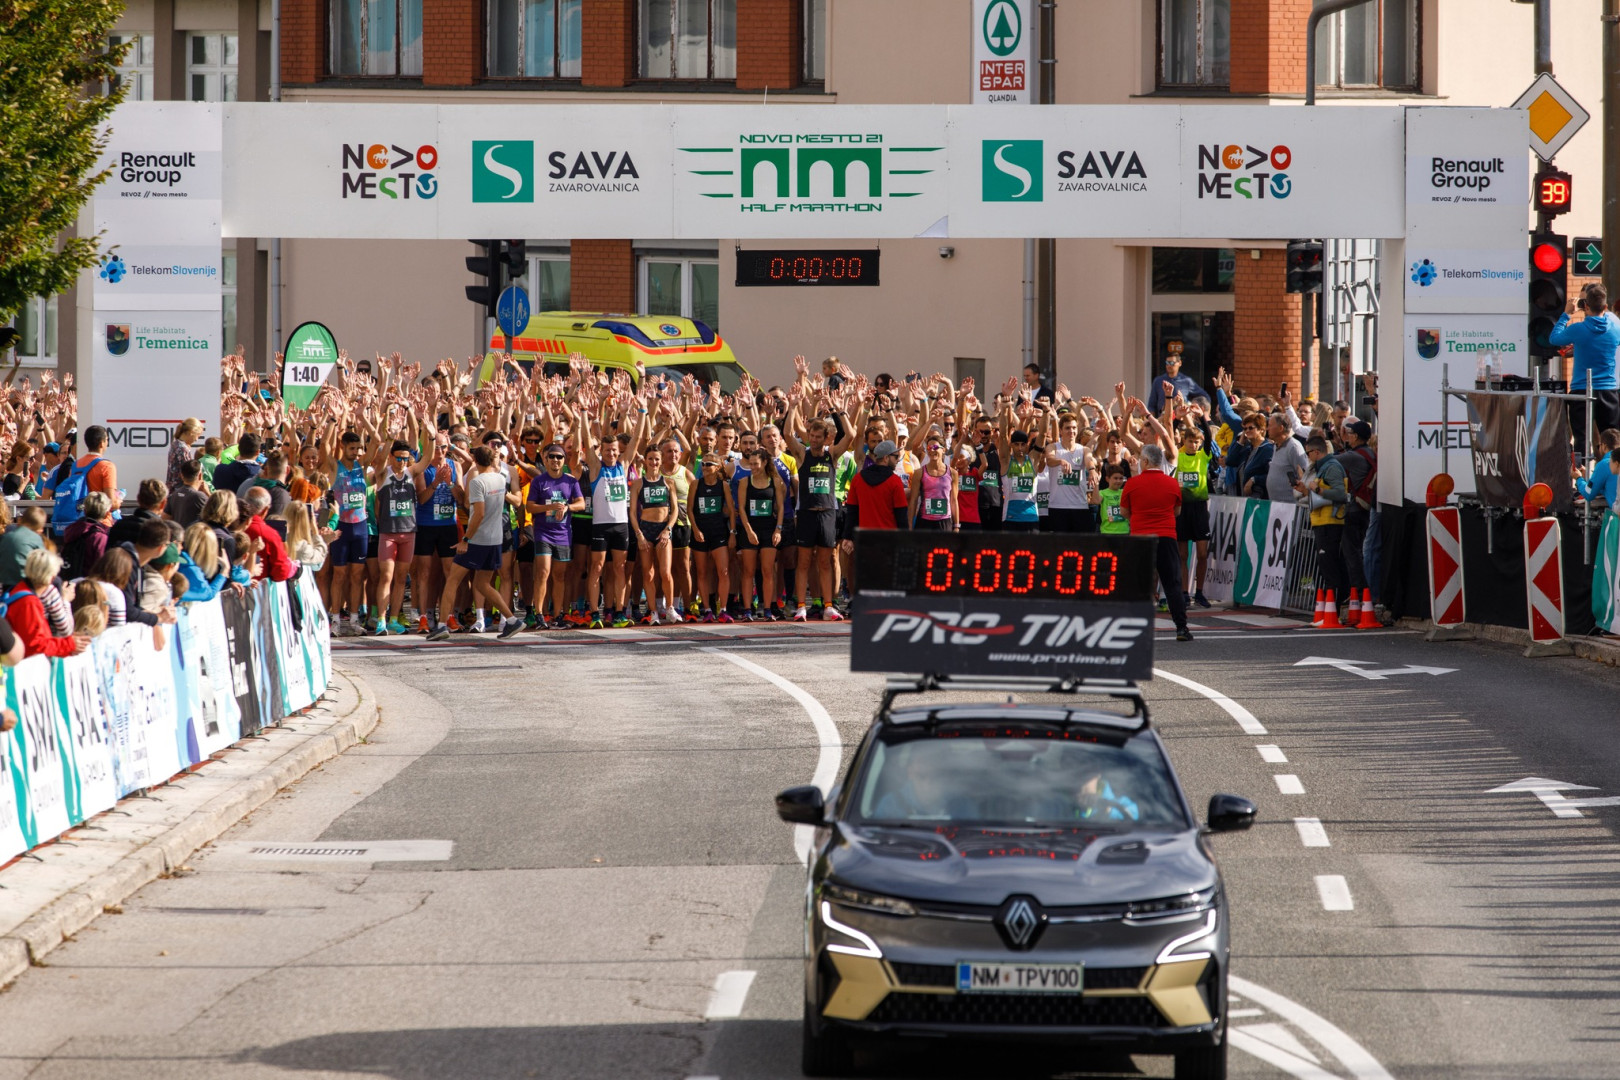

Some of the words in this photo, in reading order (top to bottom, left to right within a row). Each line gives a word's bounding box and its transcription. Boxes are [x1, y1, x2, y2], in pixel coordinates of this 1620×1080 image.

[981, 62, 1024, 75] INTER
[982, 76, 1023, 88] SPAR
[988, 94, 1017, 103] QLANDIA
[740, 134, 793, 143] NOVO
[796, 134, 862, 143] MESTO
[866, 134, 883, 143] 21
[121, 151, 196, 168] Renault
[548, 150, 640, 179] SAVA
[1057, 150, 1147, 179] SAVA
[1431, 157, 1504, 173] Renault
[120, 168, 182, 187] Group
[1431, 173, 1491, 192] Group
[342, 172, 438, 199] MESTO
[549, 182, 640, 193] ZAVAROVALNICA
[1058, 182, 1148, 192] ZAVAROVALNICA
[1198, 172, 1291, 199] MESTO
[1541, 182, 1565, 204] 39
[741, 203, 786, 212] HALF
[790, 203, 882, 212] MARATHON
[131, 265, 217, 276] TelekomSlovenije
[770, 257, 862, 279] 0:00:00
[1442, 268, 1524, 281] TelekomSlovenije
[136, 326, 151, 334] Life
[153, 326, 186, 334] Habitats
[1445, 330, 1460, 338] Life
[1462, 330, 1494, 338] Habitats
[135, 336, 209, 350] Temenica
[1445, 339, 1516, 352] Temenica
[291, 365, 319, 382] 1:40
[965, 477, 974, 485] 61
[1019, 478, 1033, 486] 178
[1184, 473, 1198, 481] 883
[349, 493, 363, 502] 625
[650, 488, 665, 496] 267
[396, 502, 410, 510] 631
[710, 498, 716, 507] 2
[761, 501, 767, 509] 4
[936, 500, 942, 508] 5
[440, 505, 454, 514] 629
[1207, 511, 1238, 562] AVA
[925, 547, 1118, 595] 0:00:00
[871, 611, 1001, 645] PRO
[1018, 614, 1148, 649] TIME
[988, 652, 1128, 665] www.protime.si
[972, 967, 1000, 987] NM
[1015, 968, 1079, 988] TPV100
